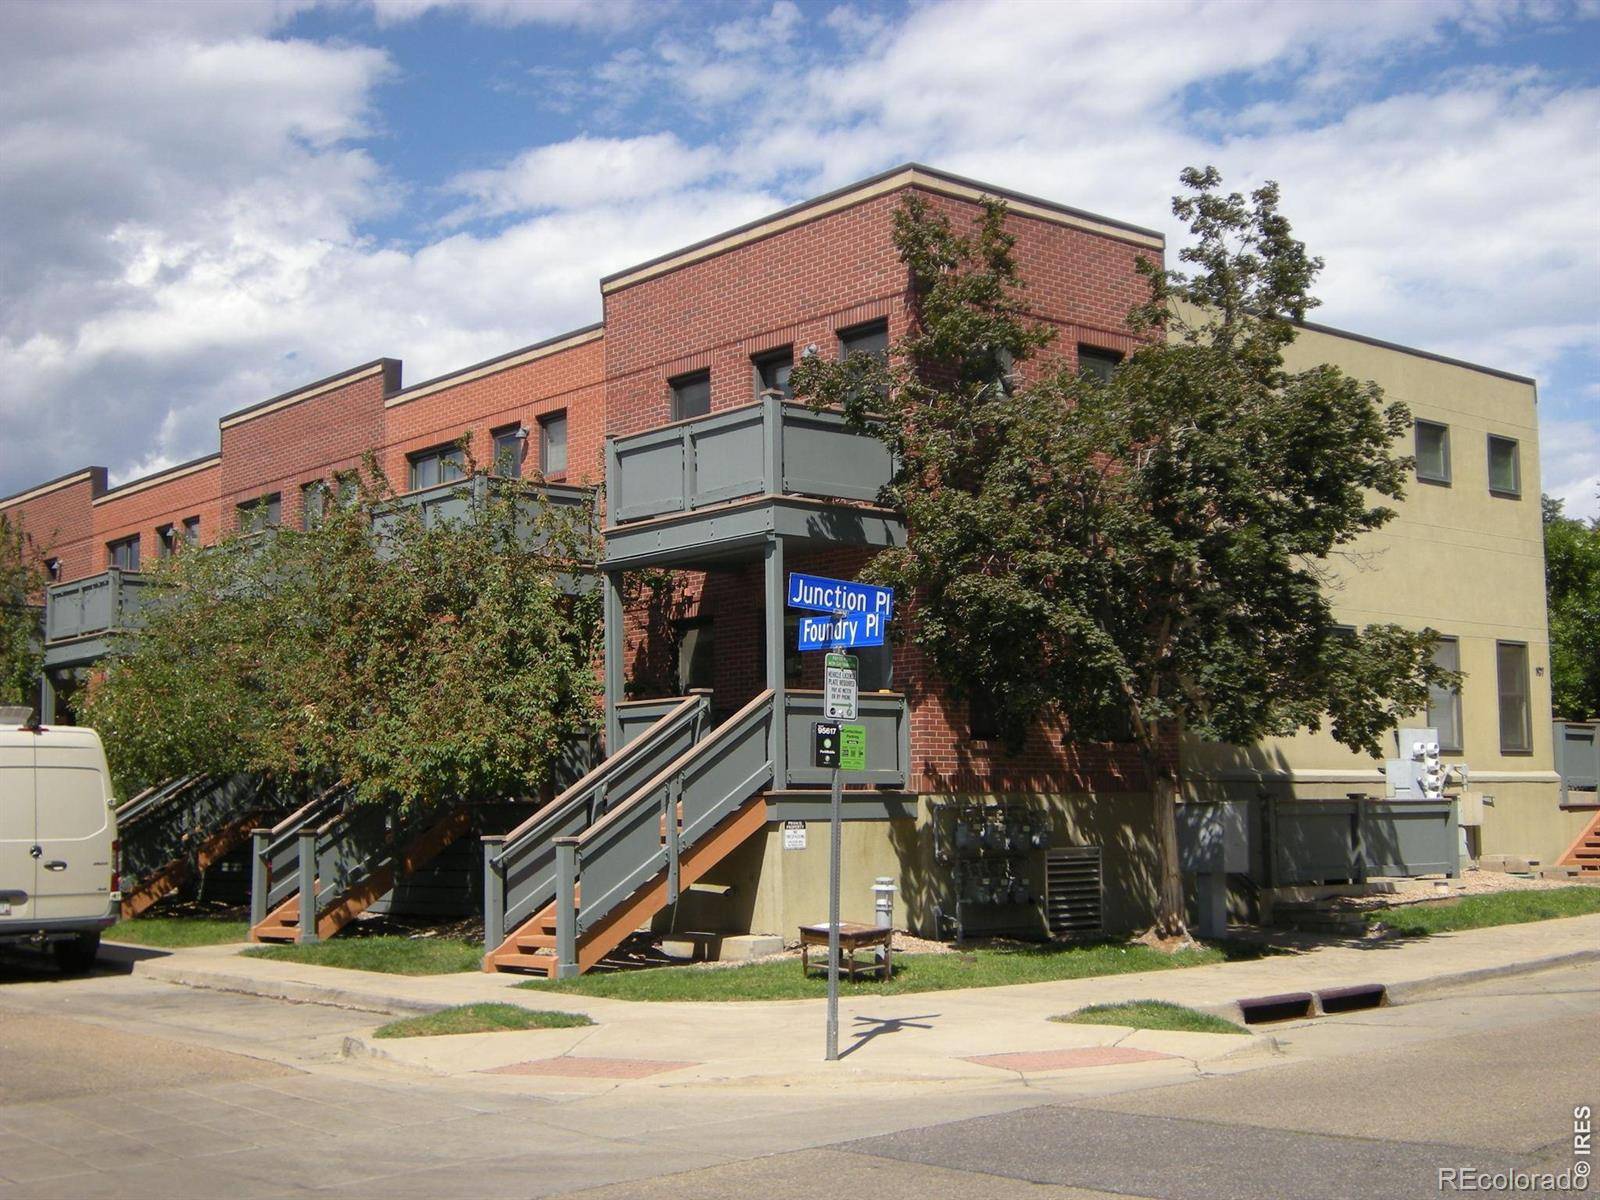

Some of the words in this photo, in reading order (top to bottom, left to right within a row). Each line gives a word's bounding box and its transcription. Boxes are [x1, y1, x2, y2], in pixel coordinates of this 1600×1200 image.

[793, 579, 867, 612] Junction
[875, 591, 890, 615] Pl
[803, 618, 858, 645] Foundry
[866, 613, 879, 637] Pl
